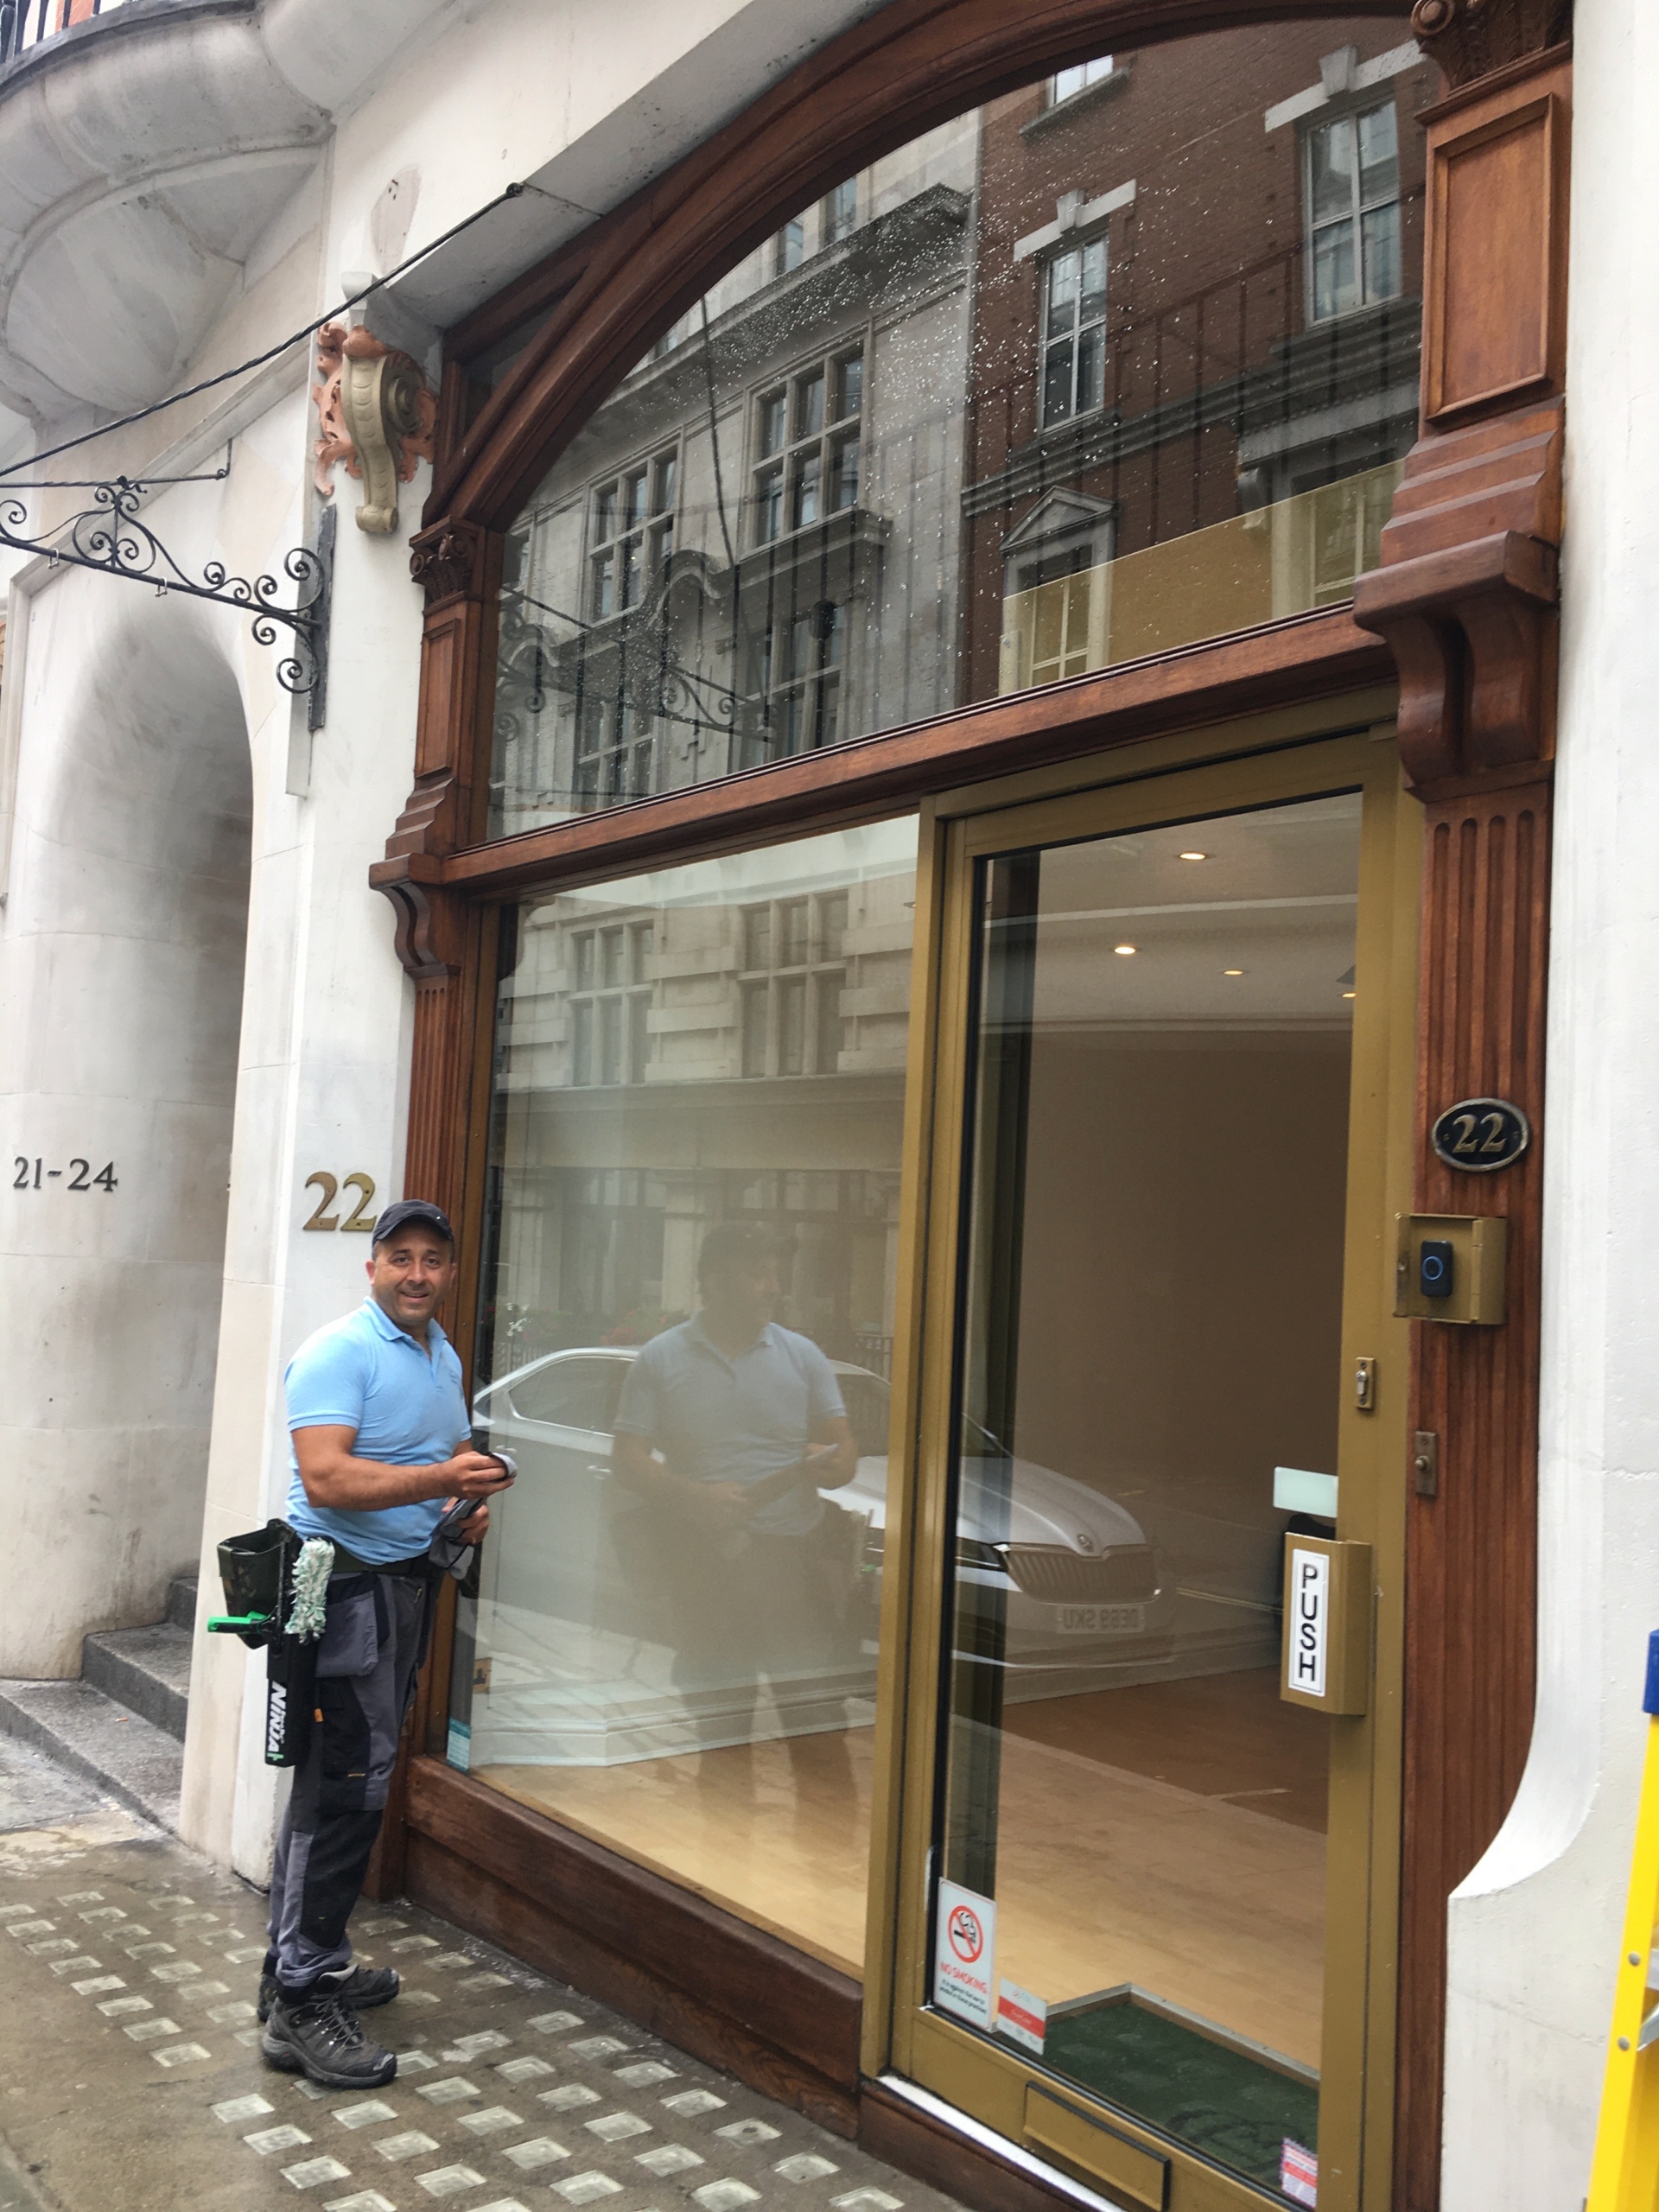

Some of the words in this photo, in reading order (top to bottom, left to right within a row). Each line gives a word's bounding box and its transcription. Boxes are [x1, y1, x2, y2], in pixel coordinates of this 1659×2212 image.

[1452, 1112, 1508, 1154] 22
[13, 1156, 119, 1192] 21-24
[302, 1171, 378, 1231] 22
[1298, 1563, 1319, 1682] PUSH
[940, 1962, 951, 1975] NO
[952, 1967, 988, 1993] SMOKING
